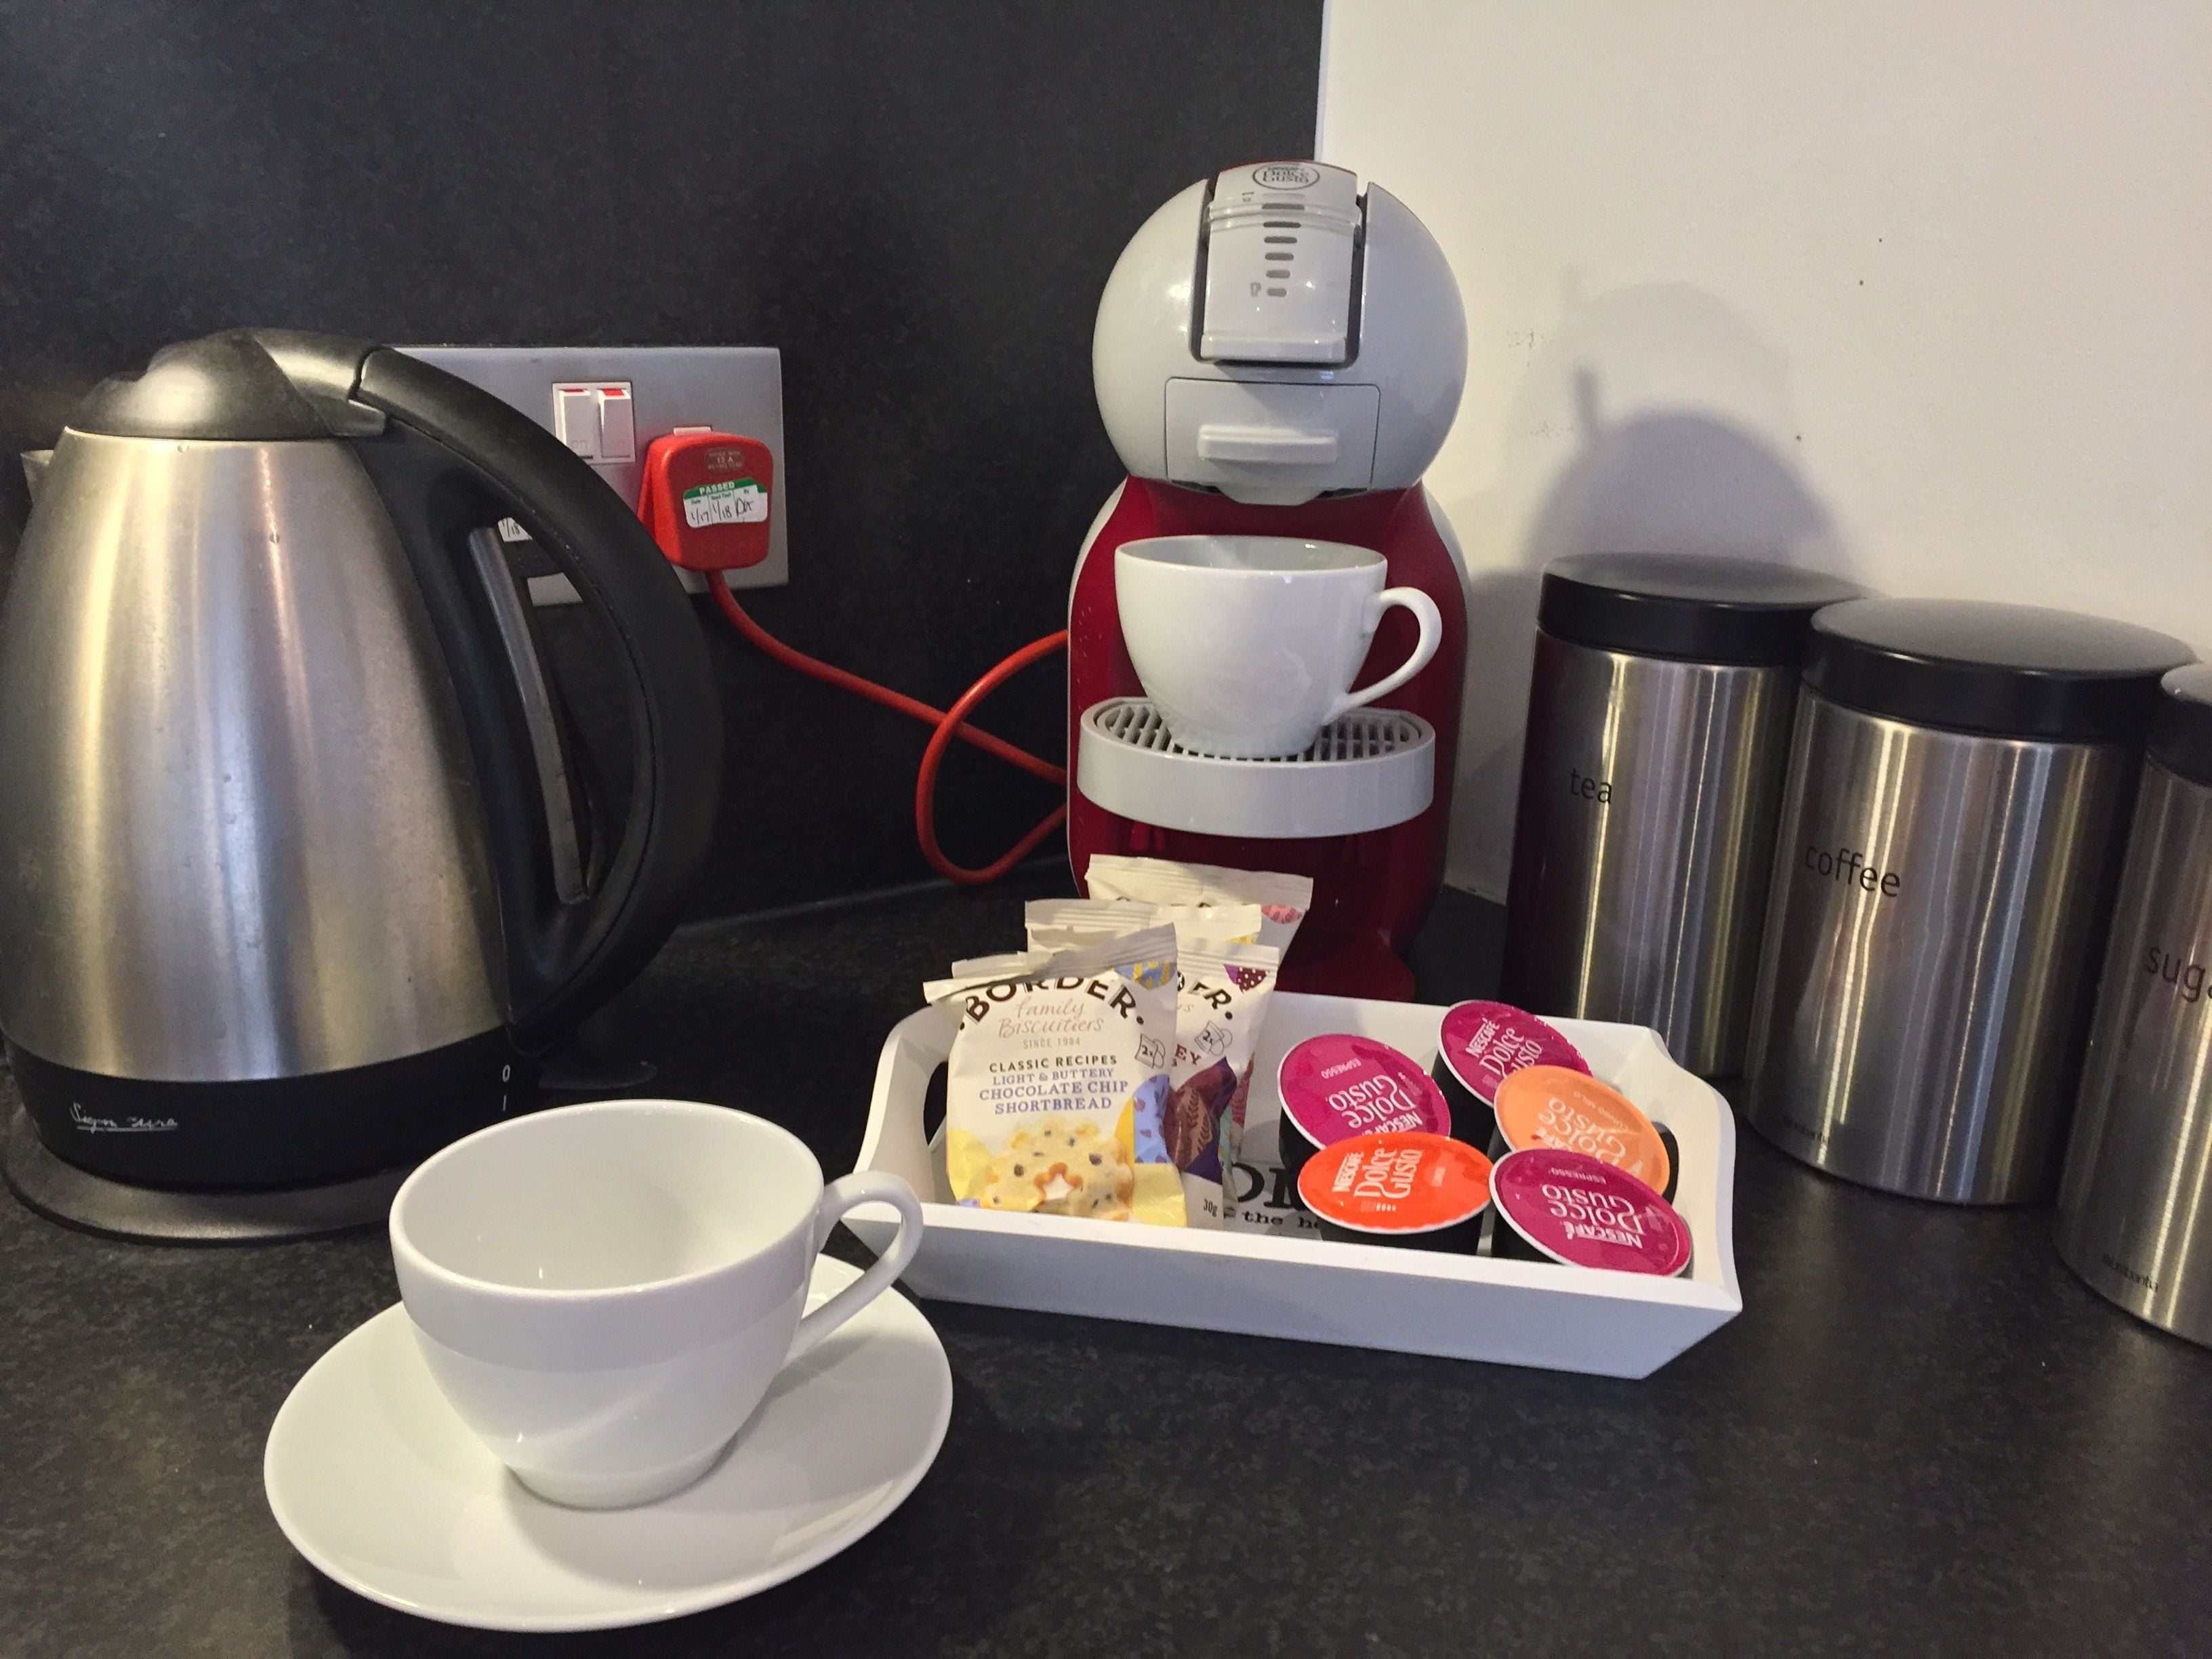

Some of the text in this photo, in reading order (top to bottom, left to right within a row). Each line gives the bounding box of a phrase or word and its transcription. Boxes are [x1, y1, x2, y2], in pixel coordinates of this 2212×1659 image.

[699, 480, 735, 496] PASSED
[1570, 768, 1612, 804] tea
[1805, 846, 1900, 897] coffee
[1023, 1036, 1081, 1050] SINCE 1984
[989, 1054, 1118, 1073] CLASSIC RECIPES
[993, 1067, 1115, 1086] LIGHT & BUTTERY
[979, 1080, 1129, 1101] CHOCOLATE CHIP
[994, 1097, 1113, 1115] SHORTBREAD
[1203, 1197, 1218, 1217] 30g
[1242, 1210, 1284, 1225] the
